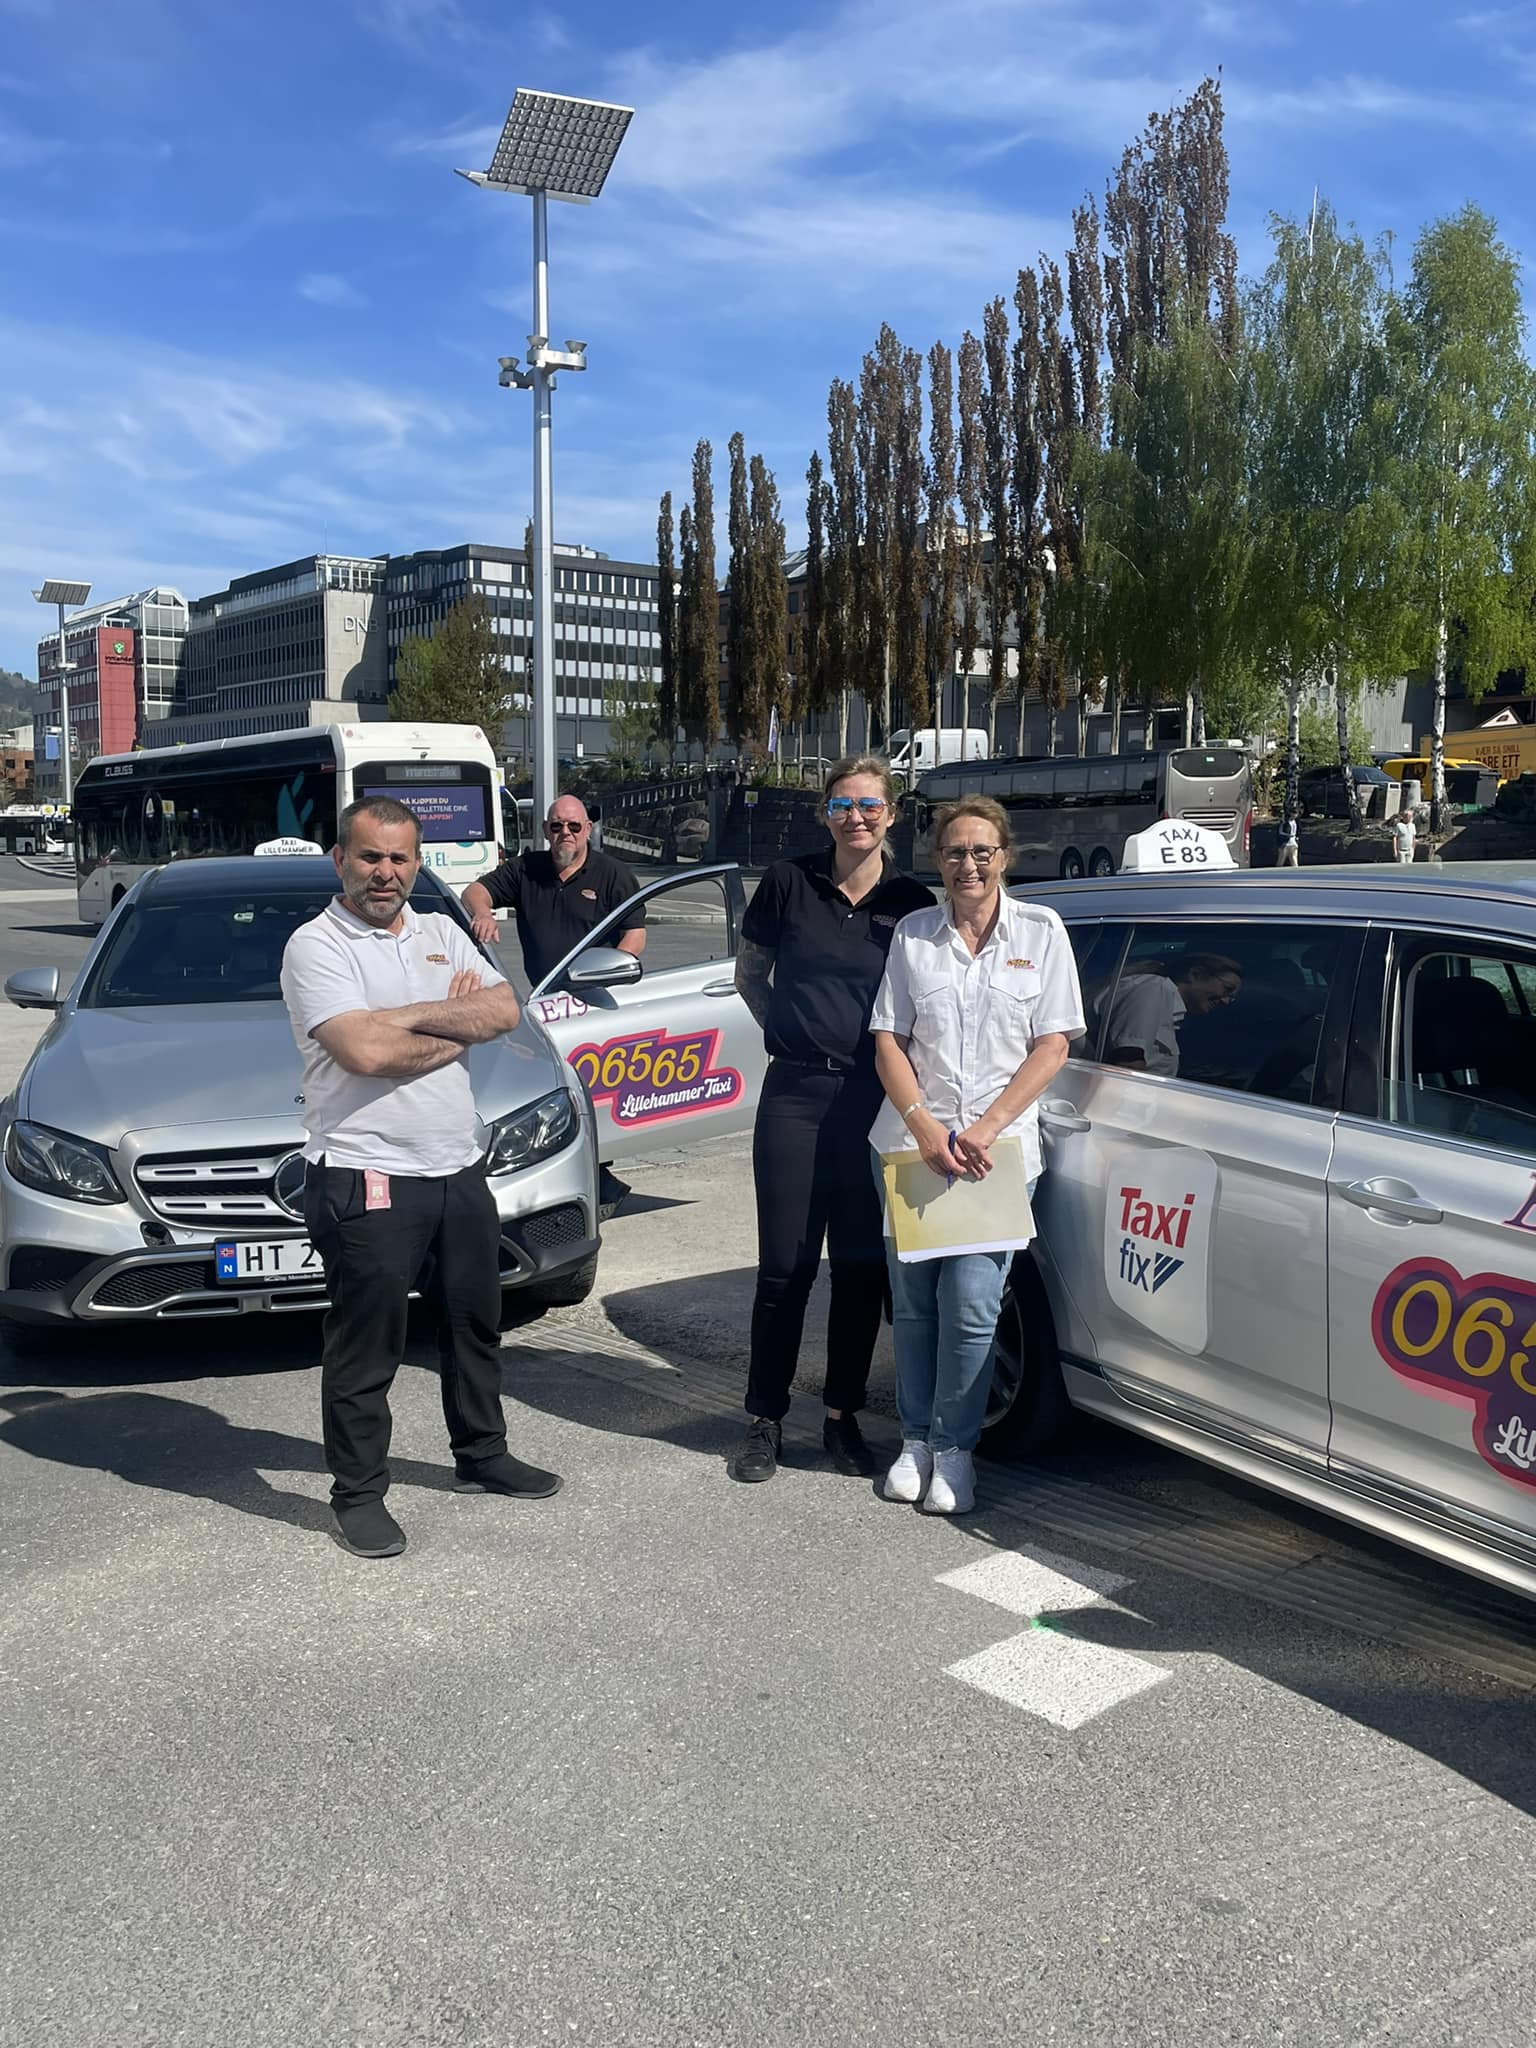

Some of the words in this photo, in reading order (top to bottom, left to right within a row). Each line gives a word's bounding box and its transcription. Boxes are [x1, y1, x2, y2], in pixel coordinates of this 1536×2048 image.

[344, 600, 378, 645] DNB
[1503, 754, 1520, 768] ETT
[1159, 828, 1200, 843] TAXI
[421, 851, 431, 867] å
[436, 852, 448, 866] EL
[1161, 847, 1176, 864] E
[1181, 846, 1207, 863] 83
[539, 996, 588, 1024] E79
[575, 1041, 702, 1089] 06565
[620, 1086, 705, 1118] Lillehammer
[704, 1076, 732, 1098] Taxi
[1120, 1187, 1195, 1249] Taxi
[224, 1264, 233, 1273] N
[245, 1245, 284, 1272] HT
[301, 1243, 319, 1268] 2
[1120, 1238, 1151, 1292] fix
